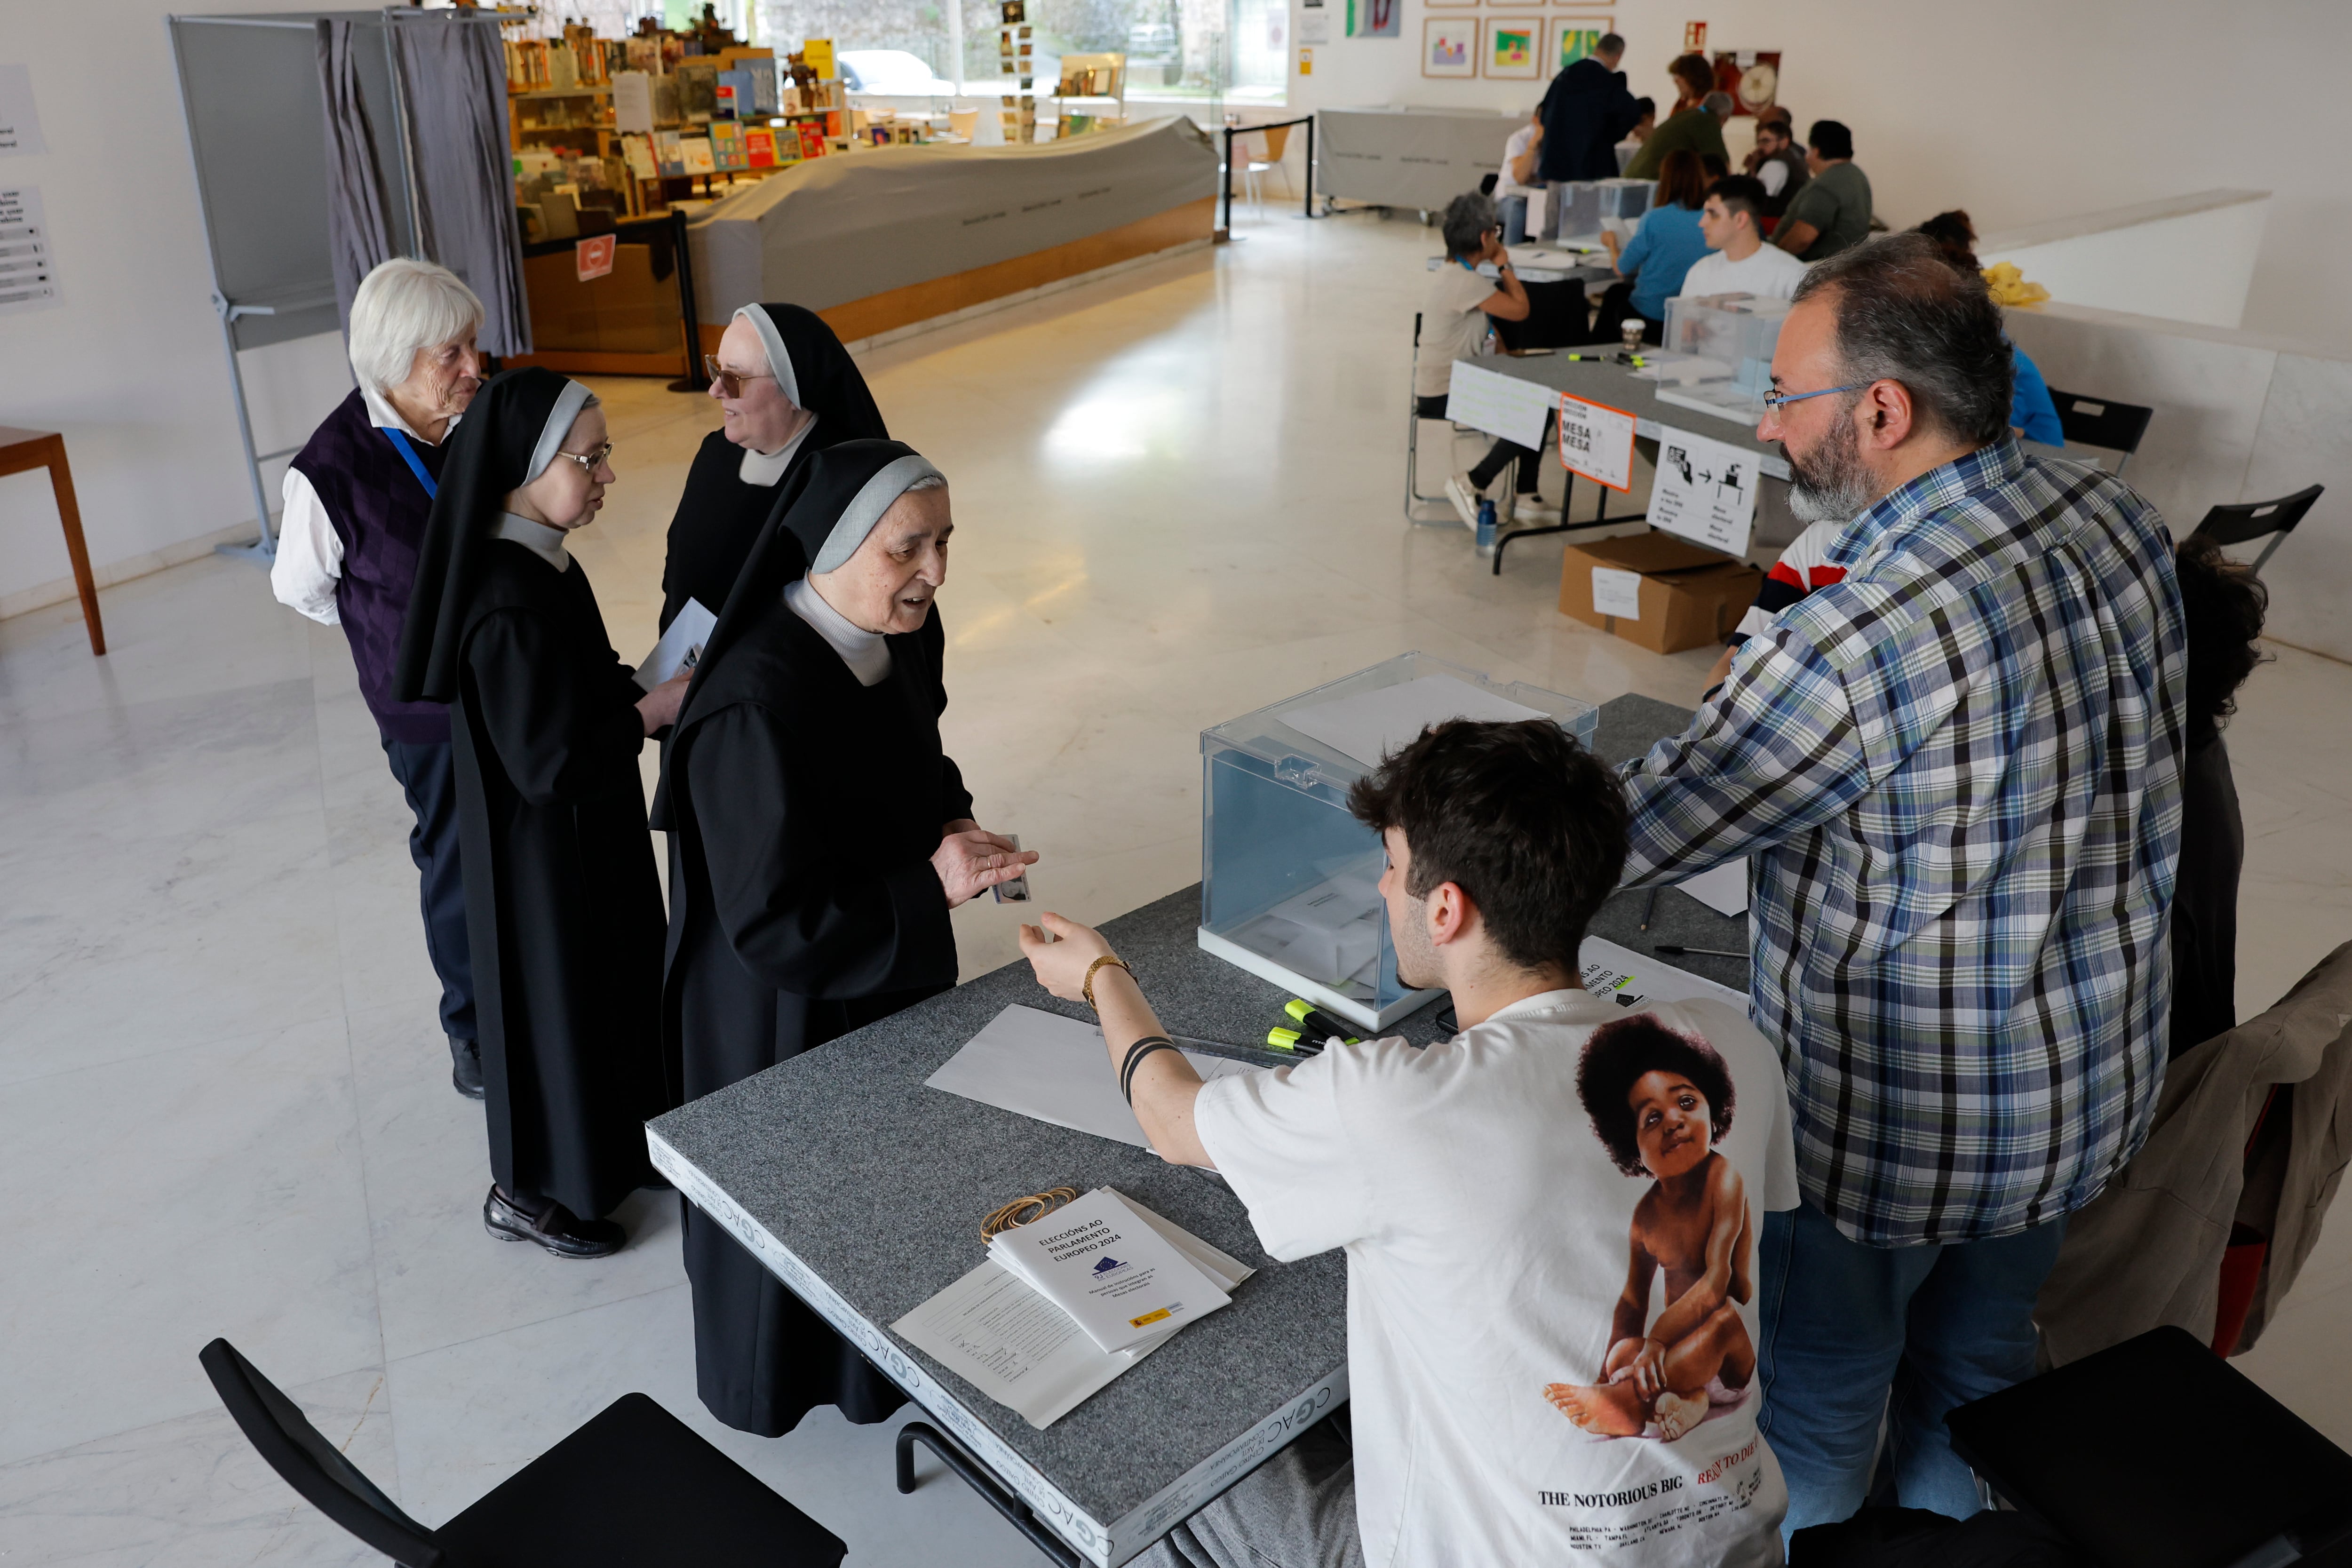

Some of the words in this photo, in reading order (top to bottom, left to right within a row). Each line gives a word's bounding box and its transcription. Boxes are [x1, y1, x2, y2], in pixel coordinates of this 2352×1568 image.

[1563, 421, 1590, 439] MESA
[1562, 434, 1589, 452] MESA
[1587, 964, 1600, 973] AO
[1609, 975, 1629, 987] 2024
[723, 1201, 764, 1248] CGAC
[1039, 1225, 1088, 1246] ELECCIÓNS
[1089, 1219, 1103, 1228] AO
[1048, 1227, 1110, 1253] PARLAMENTO
[1054, 1244, 1097, 1262] EUROPEO
[1098, 1234, 1121, 1247] 2024
[1104, 1264, 1131, 1275] ELECCIONES
[1106, 1266, 1134, 1278] EUROPEAS
[1089, 1286, 1107, 1294] Manual
[1114, 1275, 1139, 1286] instrucións
[1101, 1288, 1119, 1297] persoas
[1128, 1277, 1147, 1288] integran
[1128, 1282, 1150, 1292] electorais
[867, 1330, 919, 1387] CGAC
[1267, 1386, 1330, 1442] CGAC
[1239, 1447, 1264, 1466] CENTRO
[1241, 1443, 1255, 1457] ARTE
[996, 1460, 1019, 1485] GALEGO
[1210, 1465, 1237, 1487] GALEGO
[1538, 1491, 1570, 1505] THE
[1573, 1483, 1657, 1508] NOTORIOUS
[1660, 1476, 1682, 1493] BIG
[1698, 1460, 1722, 1484] READY
[1724, 1453, 1739, 1468] TO
[1741, 1441, 1755, 1461] DIE
[1021, 1482, 1045, 1507] CENTRO
[1047, 1491, 1114, 1557] CGAC
